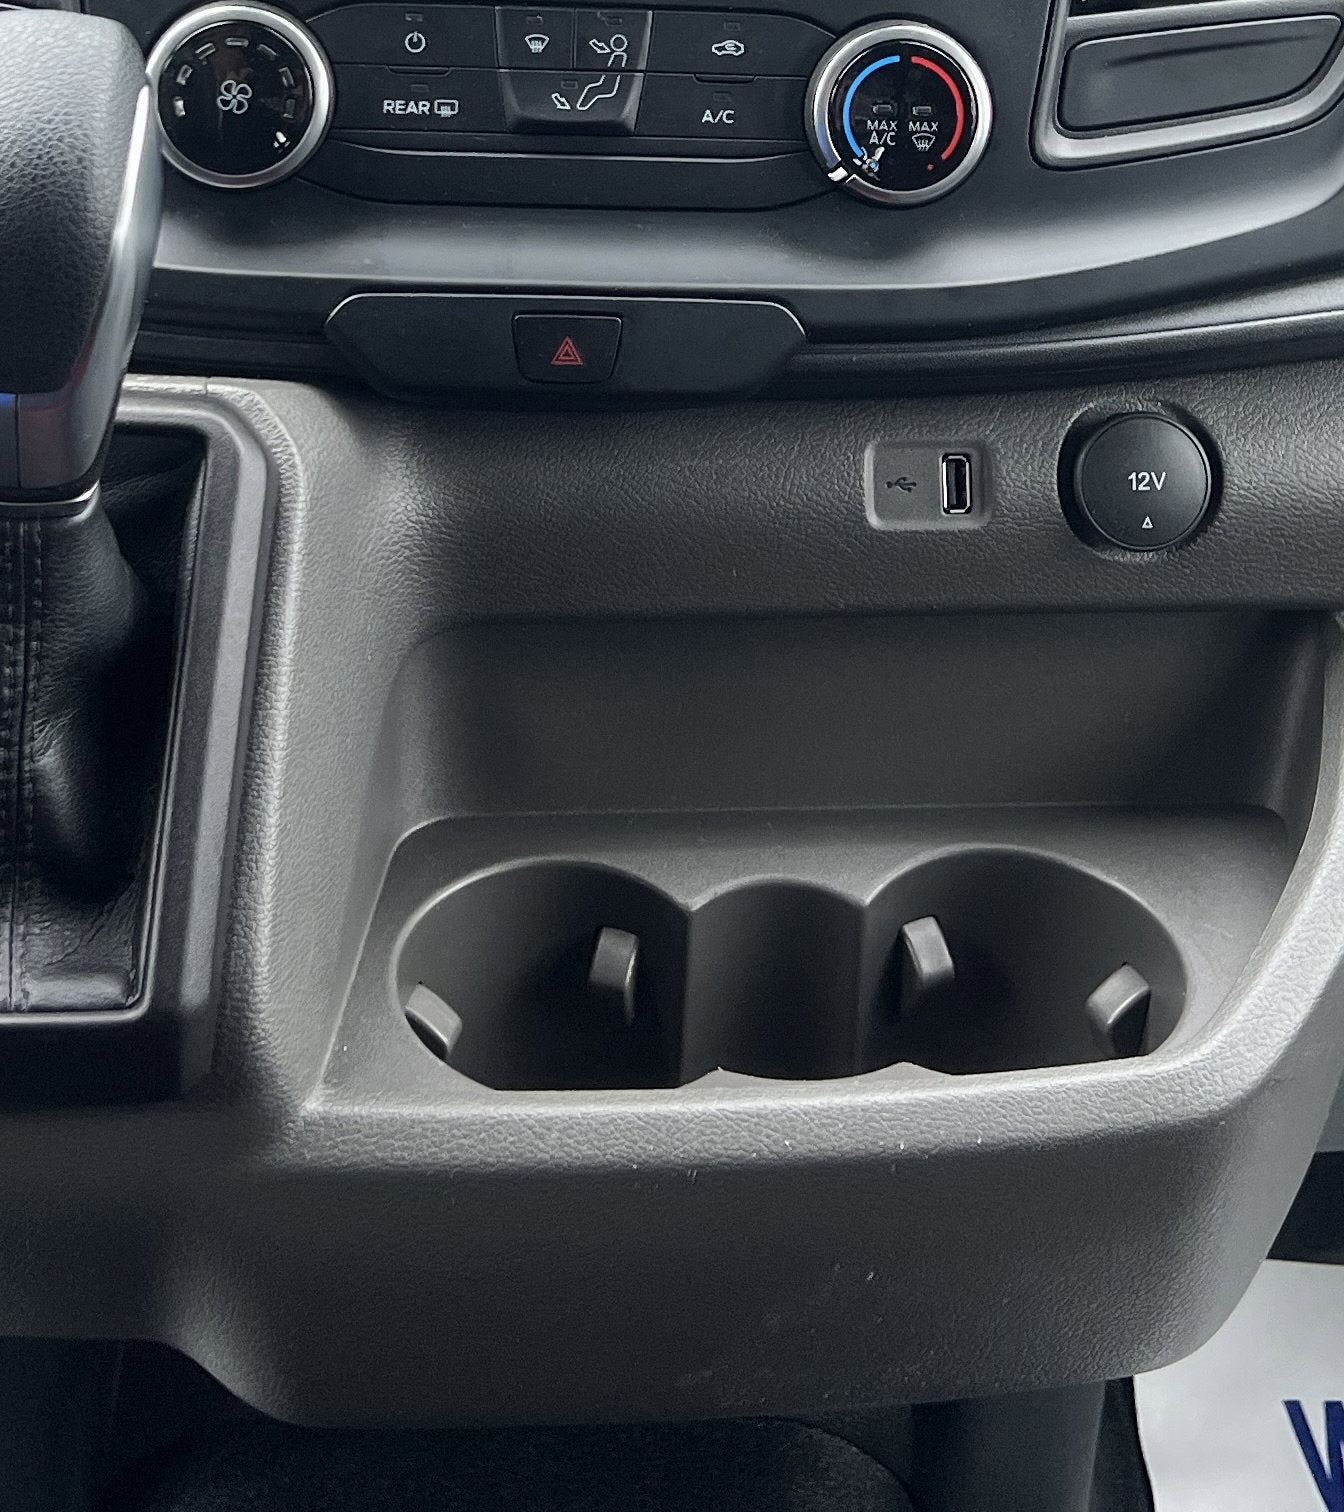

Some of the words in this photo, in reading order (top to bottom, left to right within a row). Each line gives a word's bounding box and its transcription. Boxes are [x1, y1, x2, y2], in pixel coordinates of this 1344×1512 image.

[382, 99, 431, 115] REAR
[701, 109, 735, 124] A/C
[866, 119, 898, 131] MAX
[908, 120, 939, 132] MAX
[869, 130, 896, 145] A/C
[1127, 471, 1167, 491] 12V
